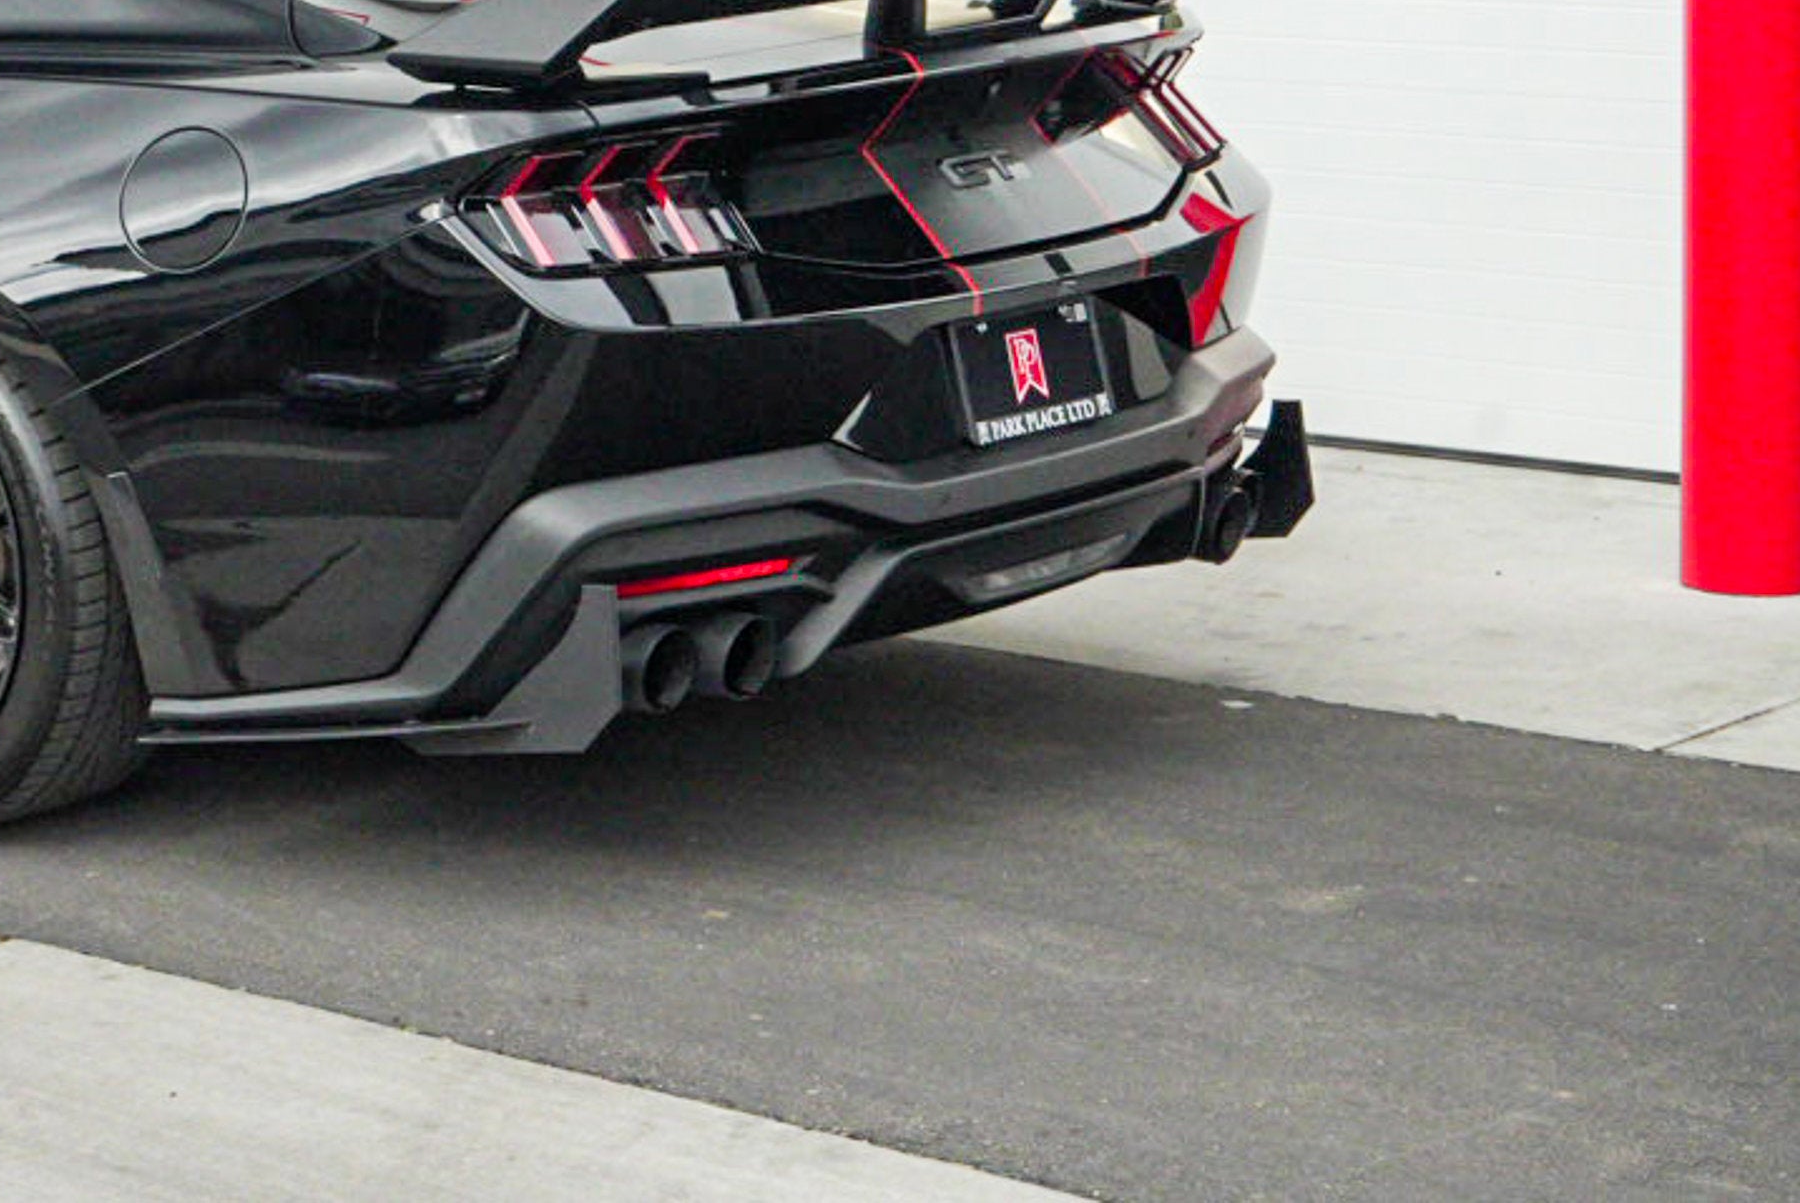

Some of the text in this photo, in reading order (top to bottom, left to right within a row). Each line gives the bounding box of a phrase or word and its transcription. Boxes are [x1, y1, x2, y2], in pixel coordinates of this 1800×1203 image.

[938, 149, 1014, 188] GT
[990, 399, 1095, 441] PARK PLACE LTD
